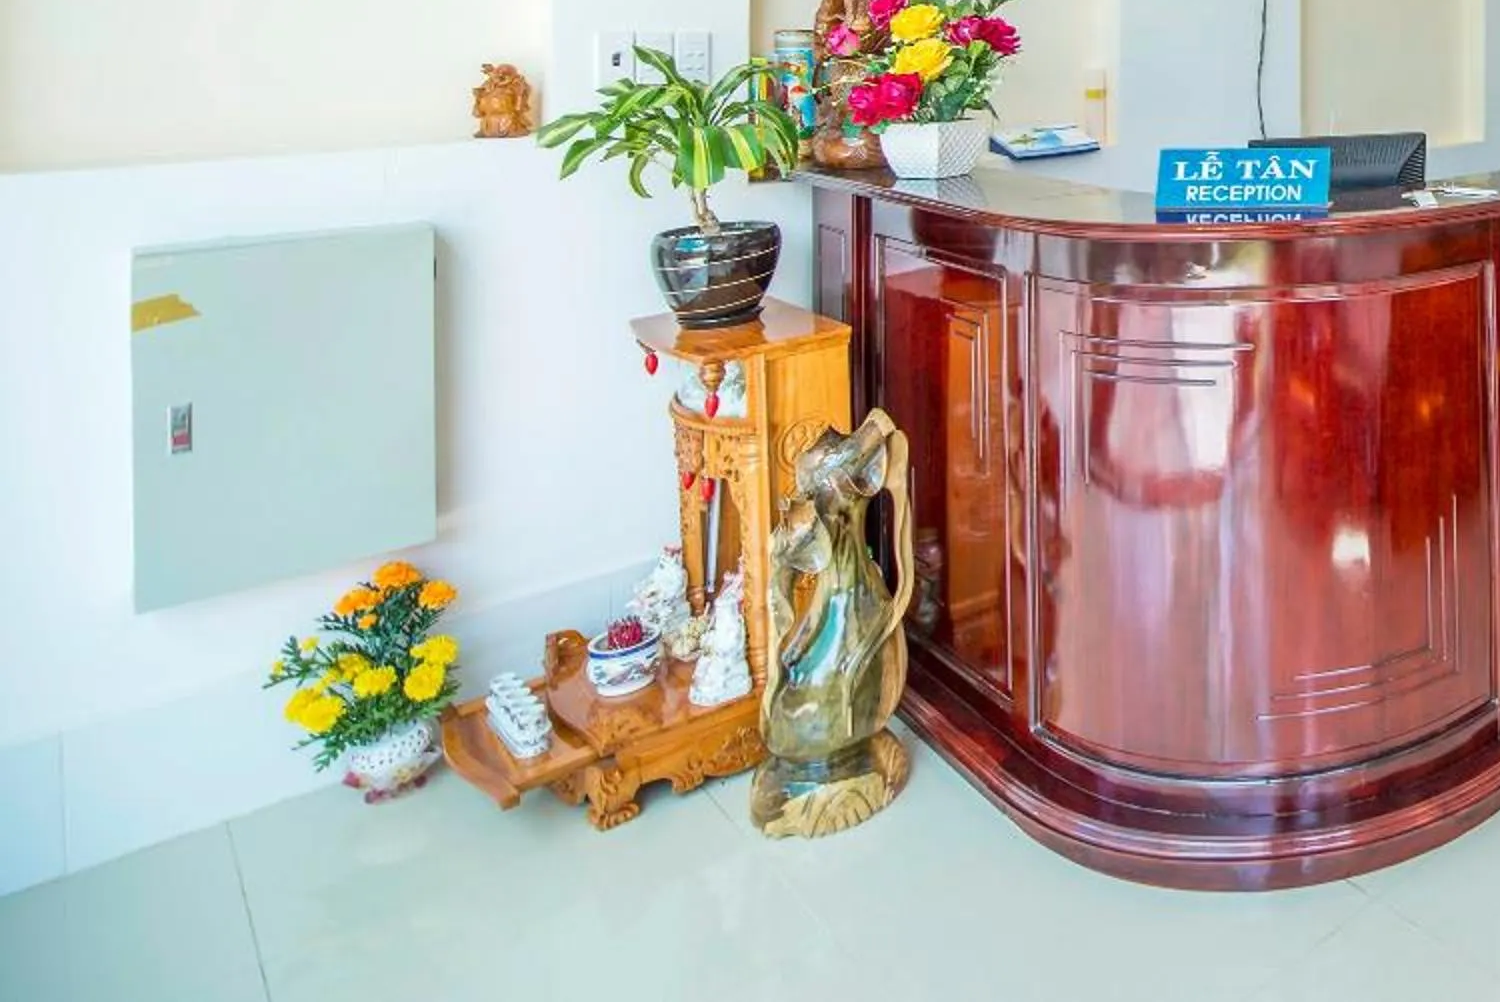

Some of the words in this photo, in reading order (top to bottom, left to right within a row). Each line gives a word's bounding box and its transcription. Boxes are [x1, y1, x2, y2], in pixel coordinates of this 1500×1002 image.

[1172, 151, 1223, 180] LỄ
[1237, 155, 1319, 179] TÂN
[1186, 185, 1302, 201] RECEPTION
